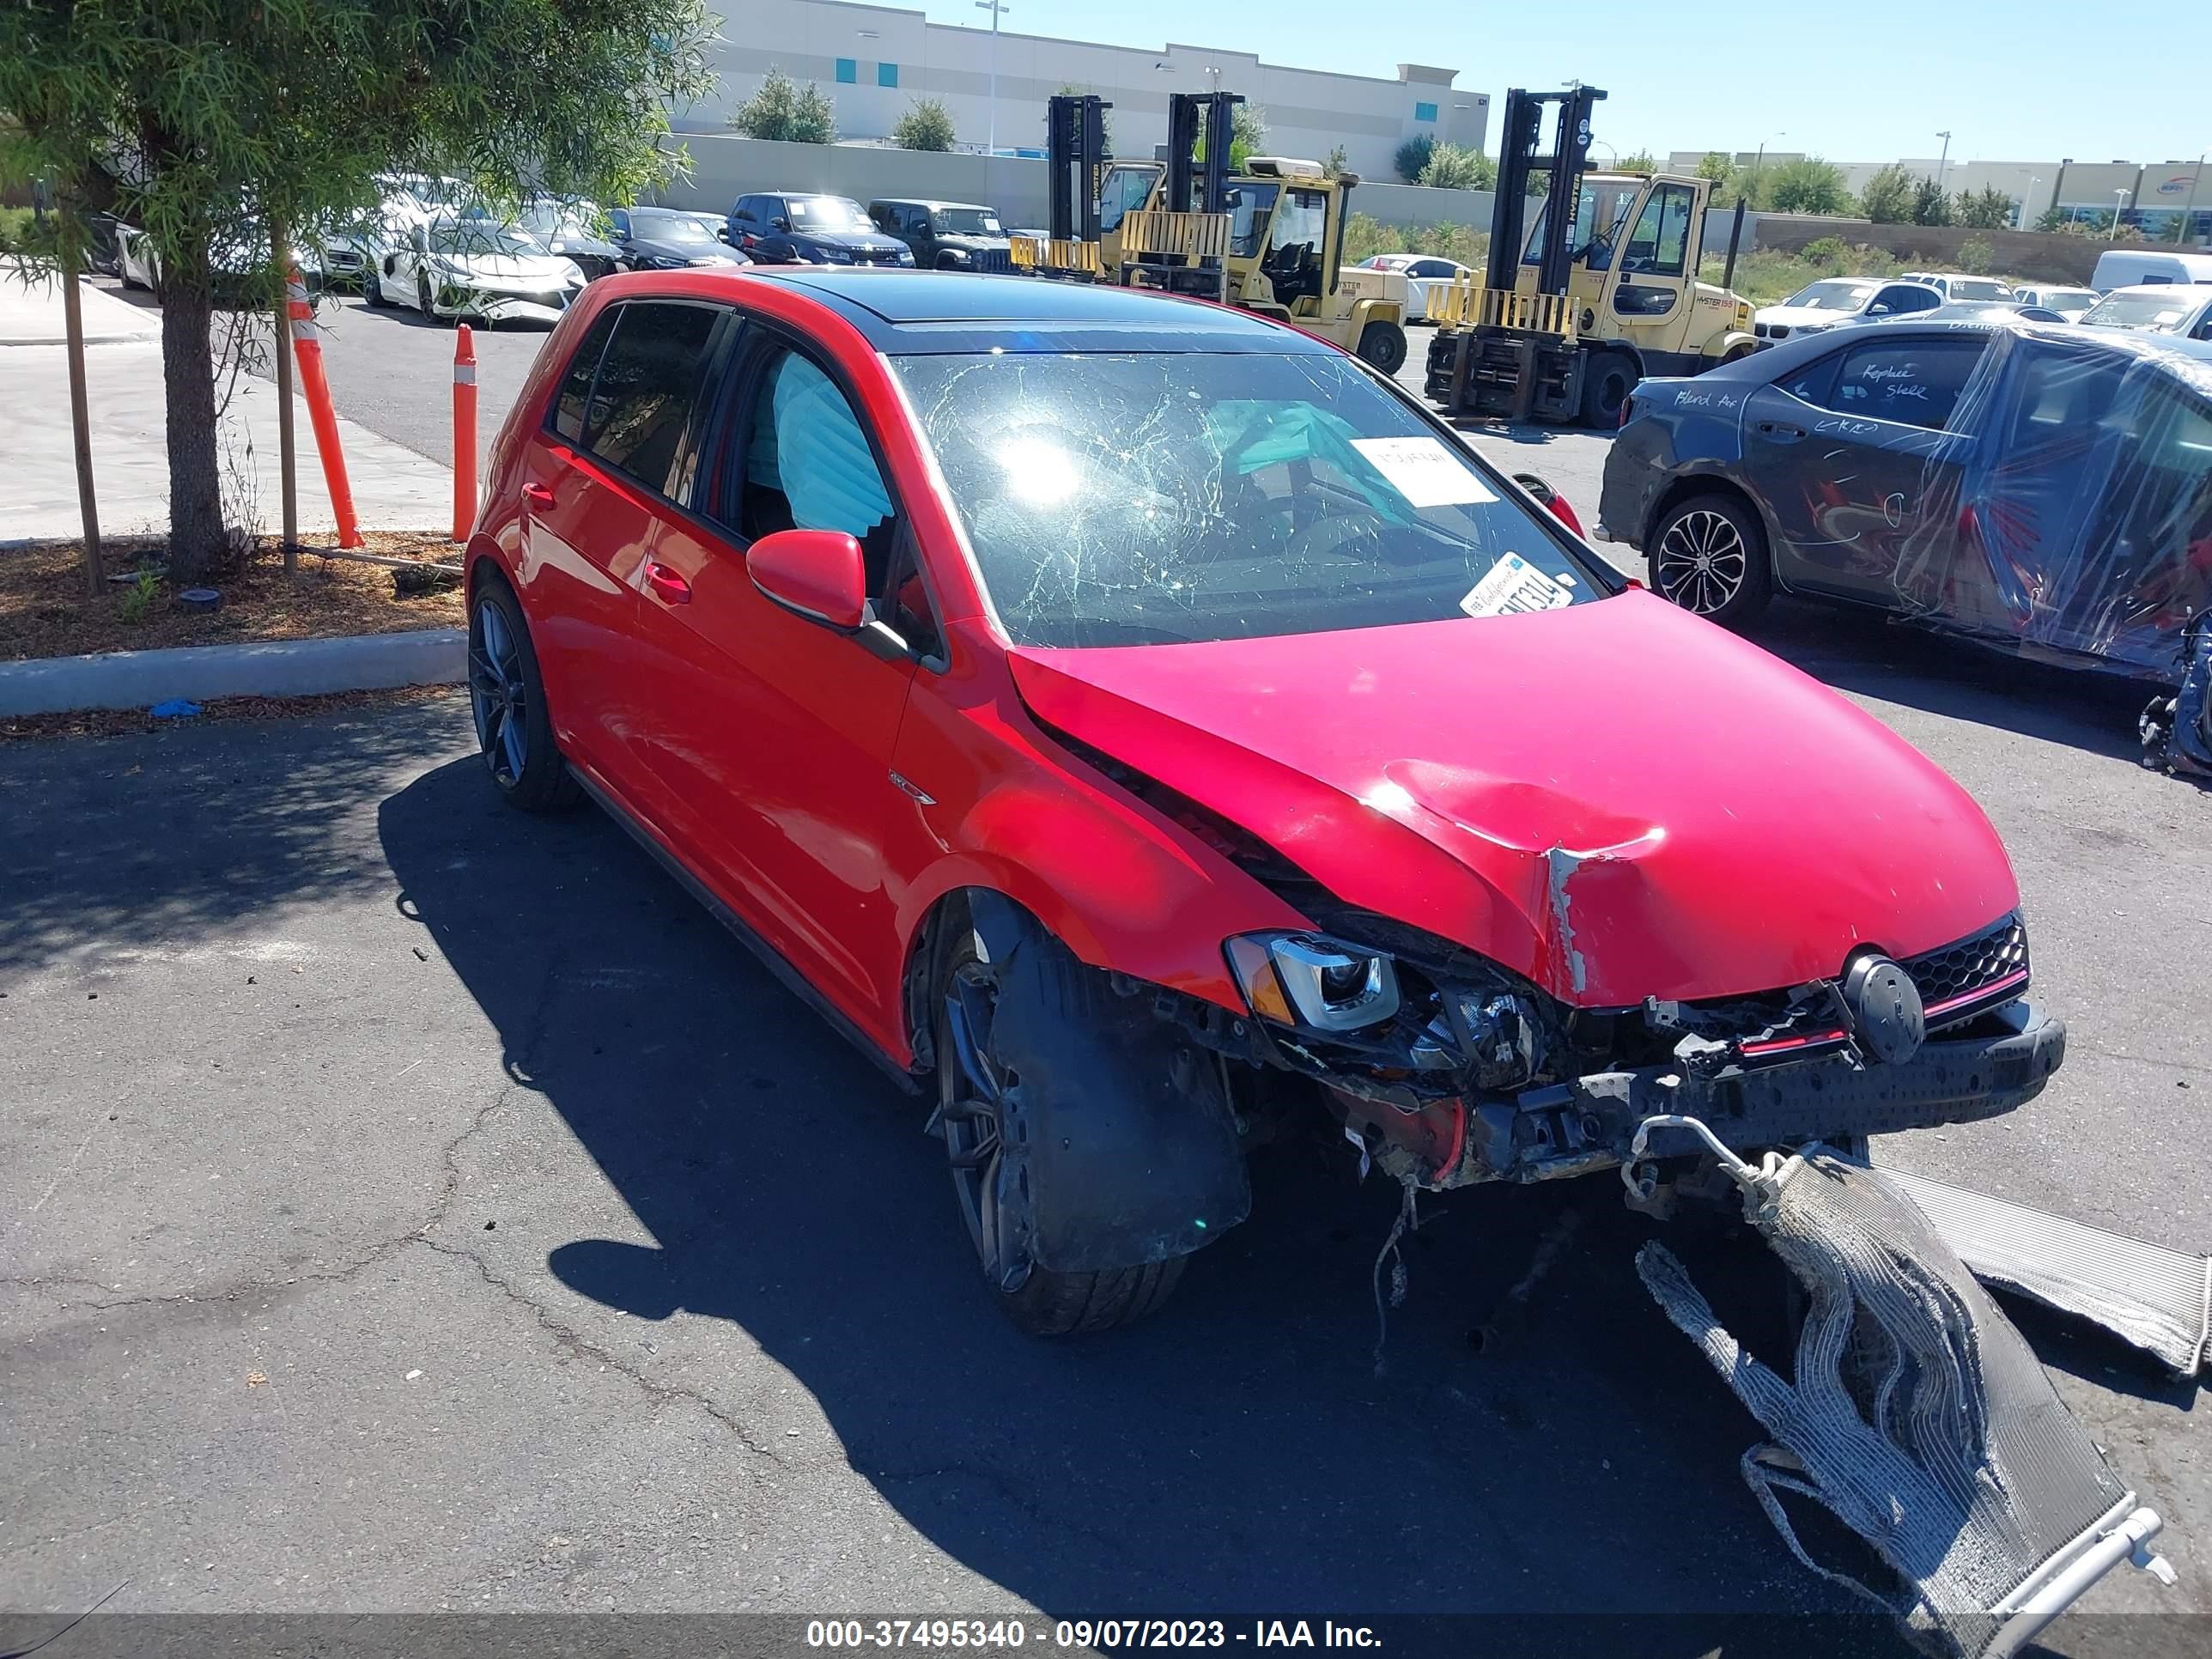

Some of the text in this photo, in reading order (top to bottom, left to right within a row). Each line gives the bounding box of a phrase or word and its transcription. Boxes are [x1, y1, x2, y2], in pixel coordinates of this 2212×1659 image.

[1569, 173, 1581, 221] HYSTER
[1338, 281, 1361, 289] YSTER
[1697, 295, 1734, 308] HYSTER 155
